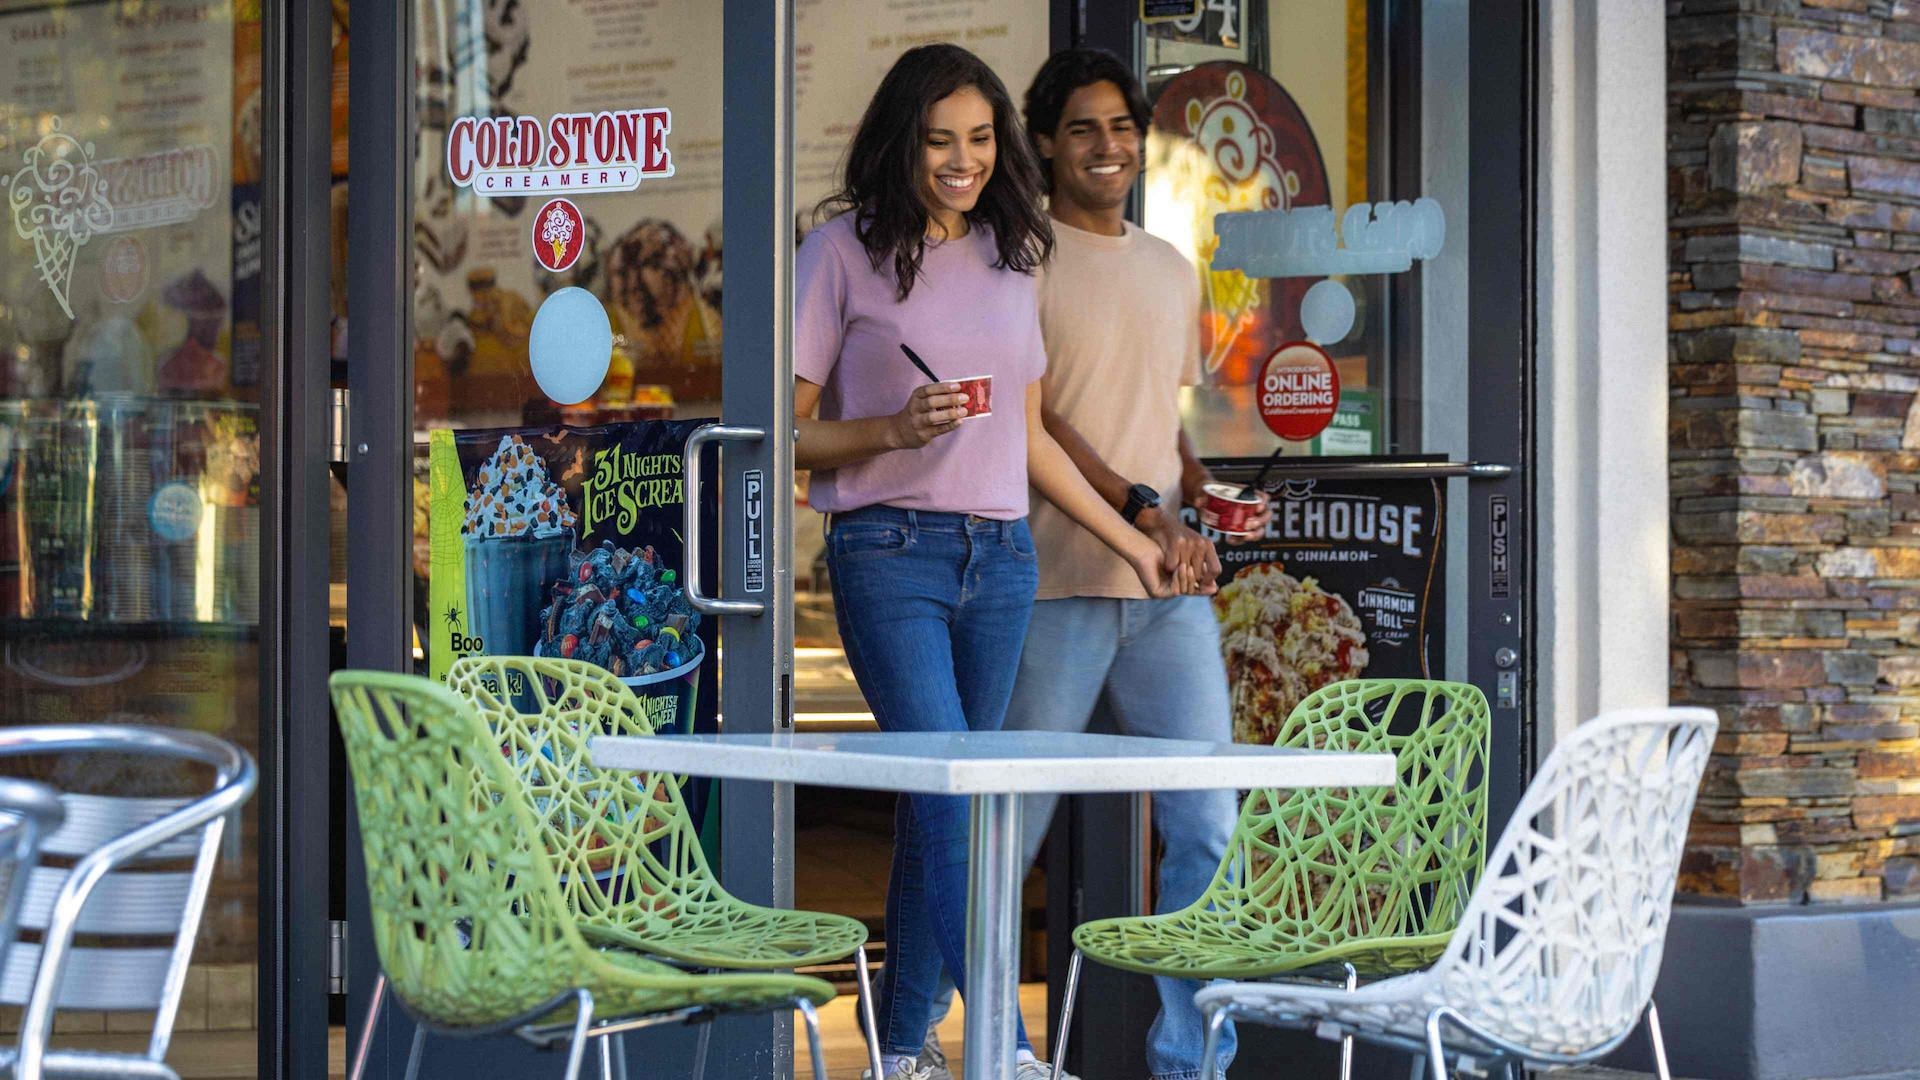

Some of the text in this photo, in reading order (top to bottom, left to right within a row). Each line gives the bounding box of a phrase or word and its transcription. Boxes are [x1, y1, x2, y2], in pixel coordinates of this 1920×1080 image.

[1174, 0, 1237, 38] 4
[450, 119, 542, 182] COLD
[549, 111, 668, 174] STONE
[486, 170, 627, 188] CREAMERY
[1264, 373, 1332, 392] ONLINE
[1263, 391, 1334, 407] ORDERING
[594, 442, 681, 490] 31 NIGHTS
[580, 478, 704, 540] ICE SCREA
[747, 480, 761, 559] PULL
[1179, 500, 1422, 557] EEHOUSE
[1492, 503, 1507, 572] PUSH
[1226, 551, 1371, 562] COFFEE CINNAMON
[1357, 590, 1416, 613] CINNAMON
[1375, 609, 1403, 629] ROLL
[451, 632, 484, 652] Boo
[440, 671, 448, 682] is
